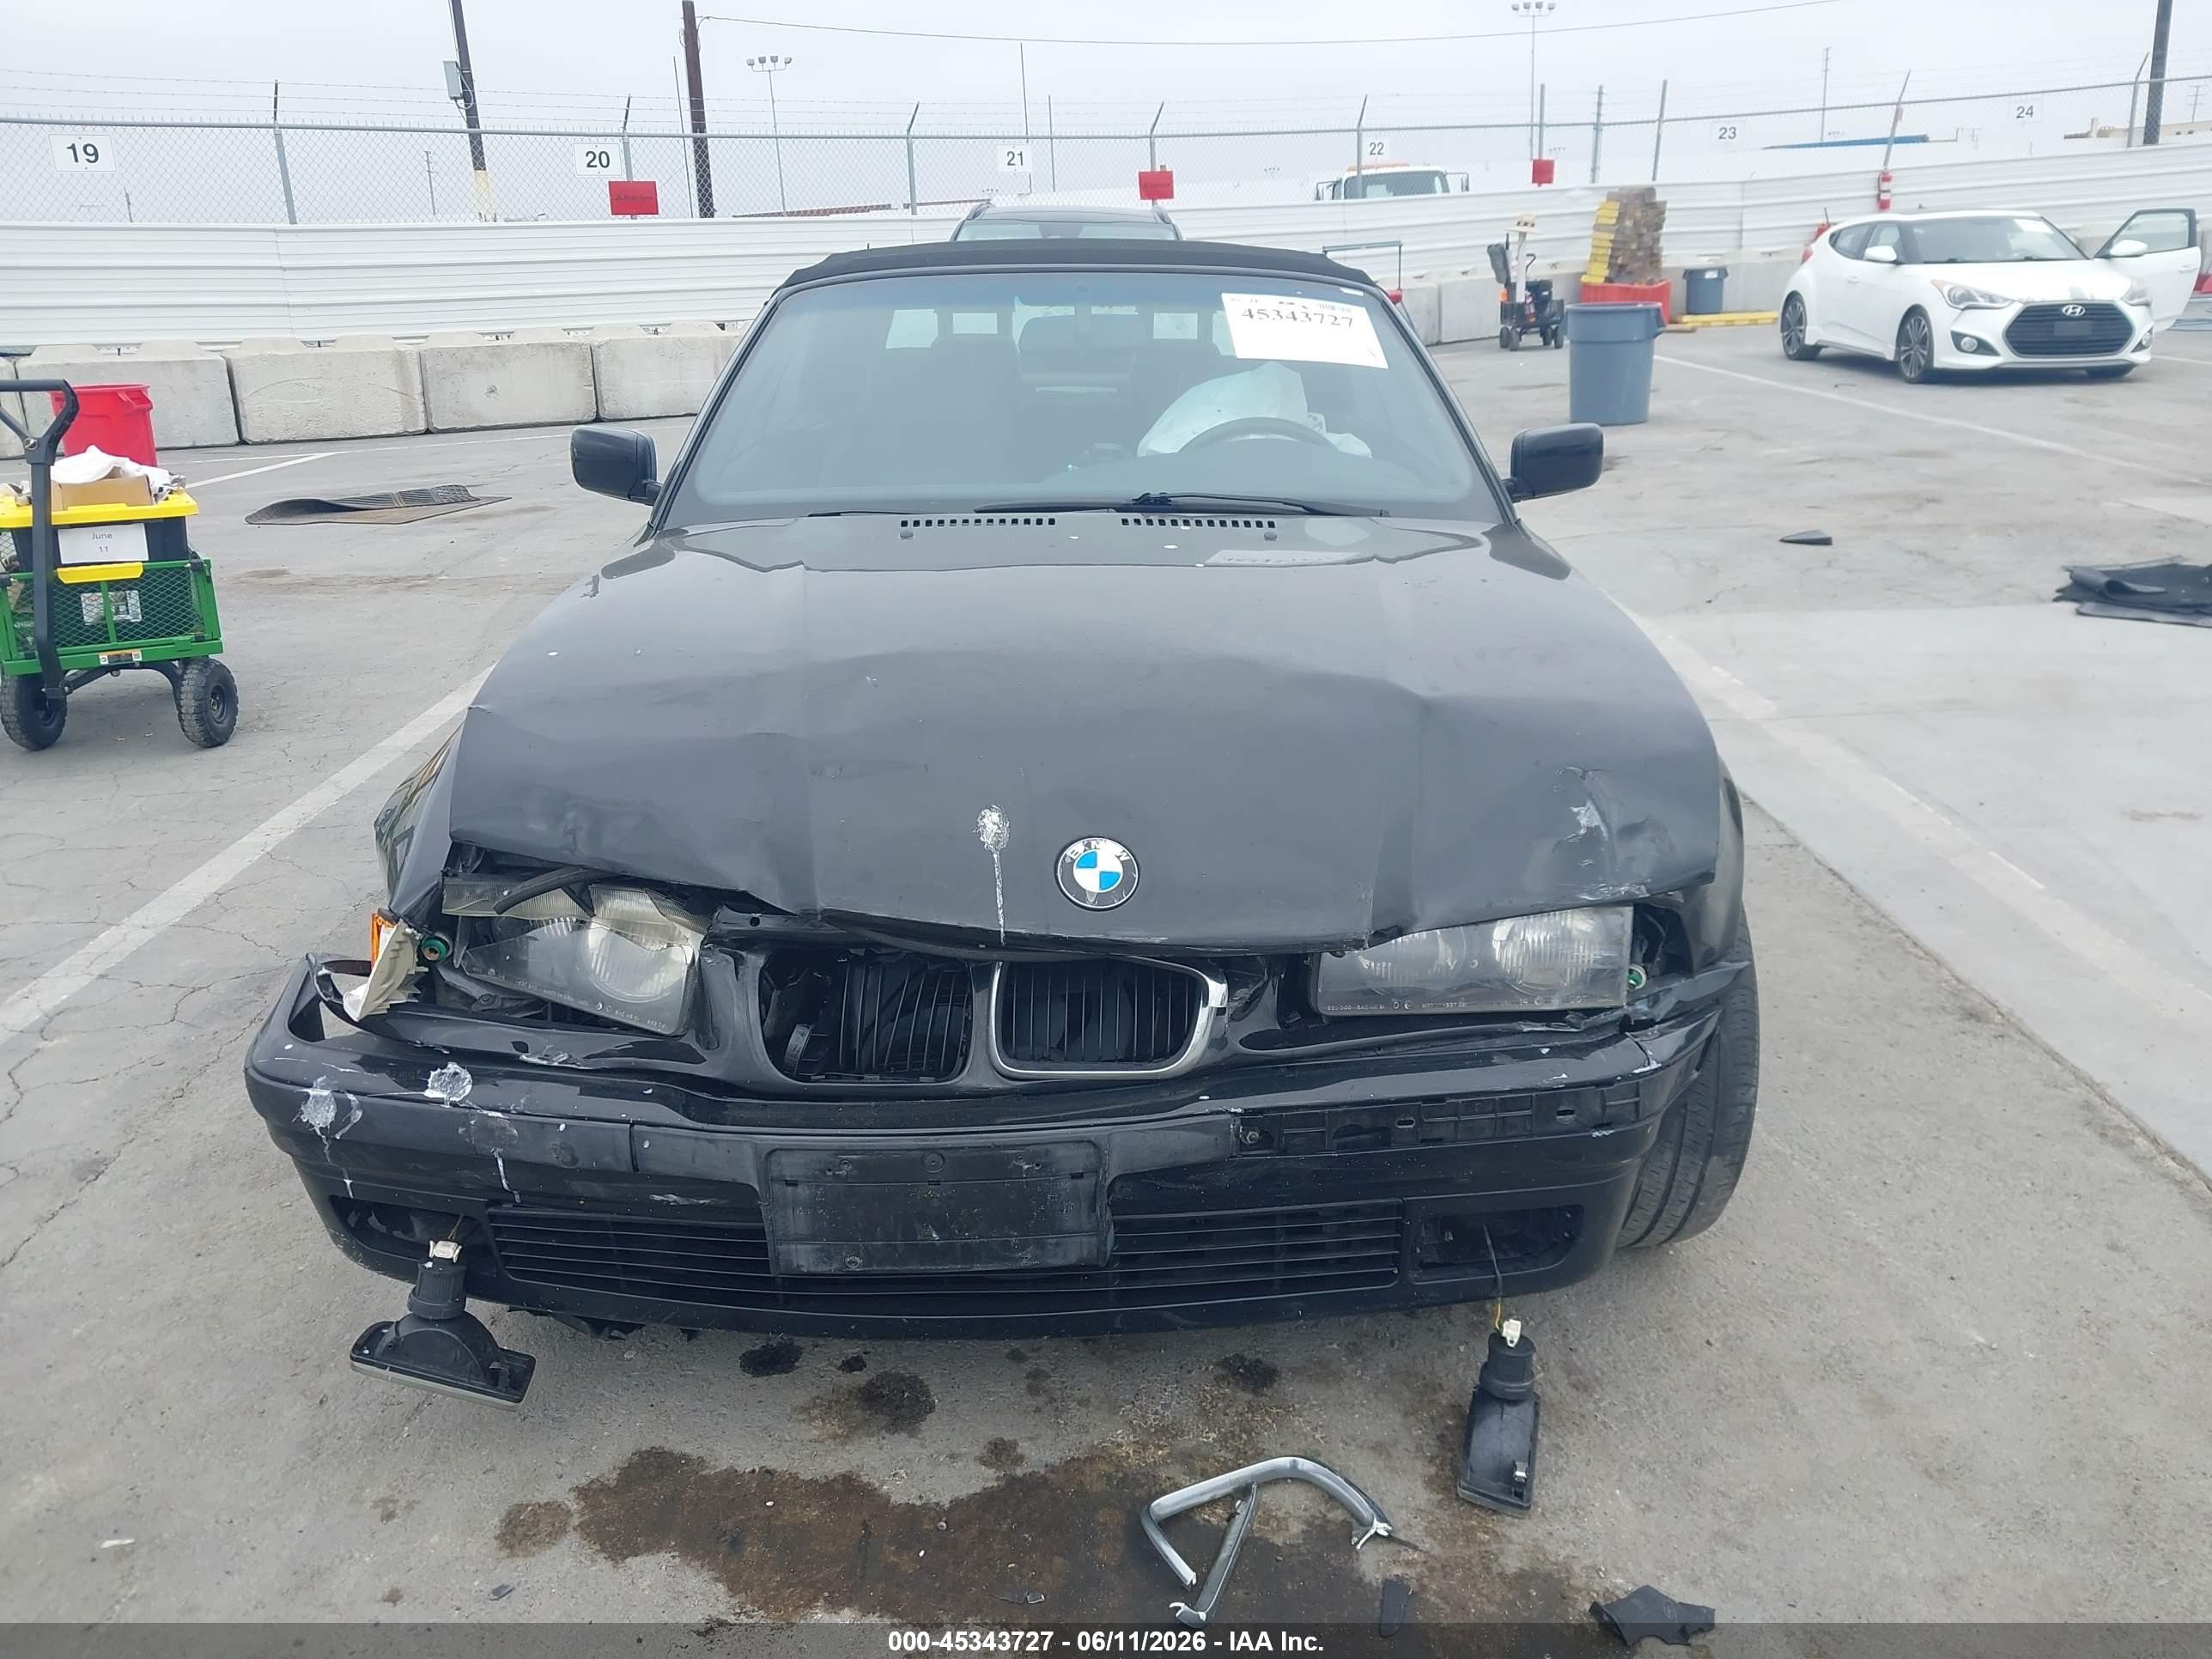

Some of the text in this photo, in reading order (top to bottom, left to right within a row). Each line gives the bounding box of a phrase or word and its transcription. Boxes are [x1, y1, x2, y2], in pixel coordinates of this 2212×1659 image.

[2015, 105, 2034, 118] 24
[1718, 126, 1737, 140] 23
[66, 143, 100, 164] 19
[1369, 141, 1384, 155] 22
[585, 150, 611, 168] 20
[1006, 150, 1024, 167] 21
[1242, 308, 1354, 328] 45343727
[99, 545, 109, 554] 11
